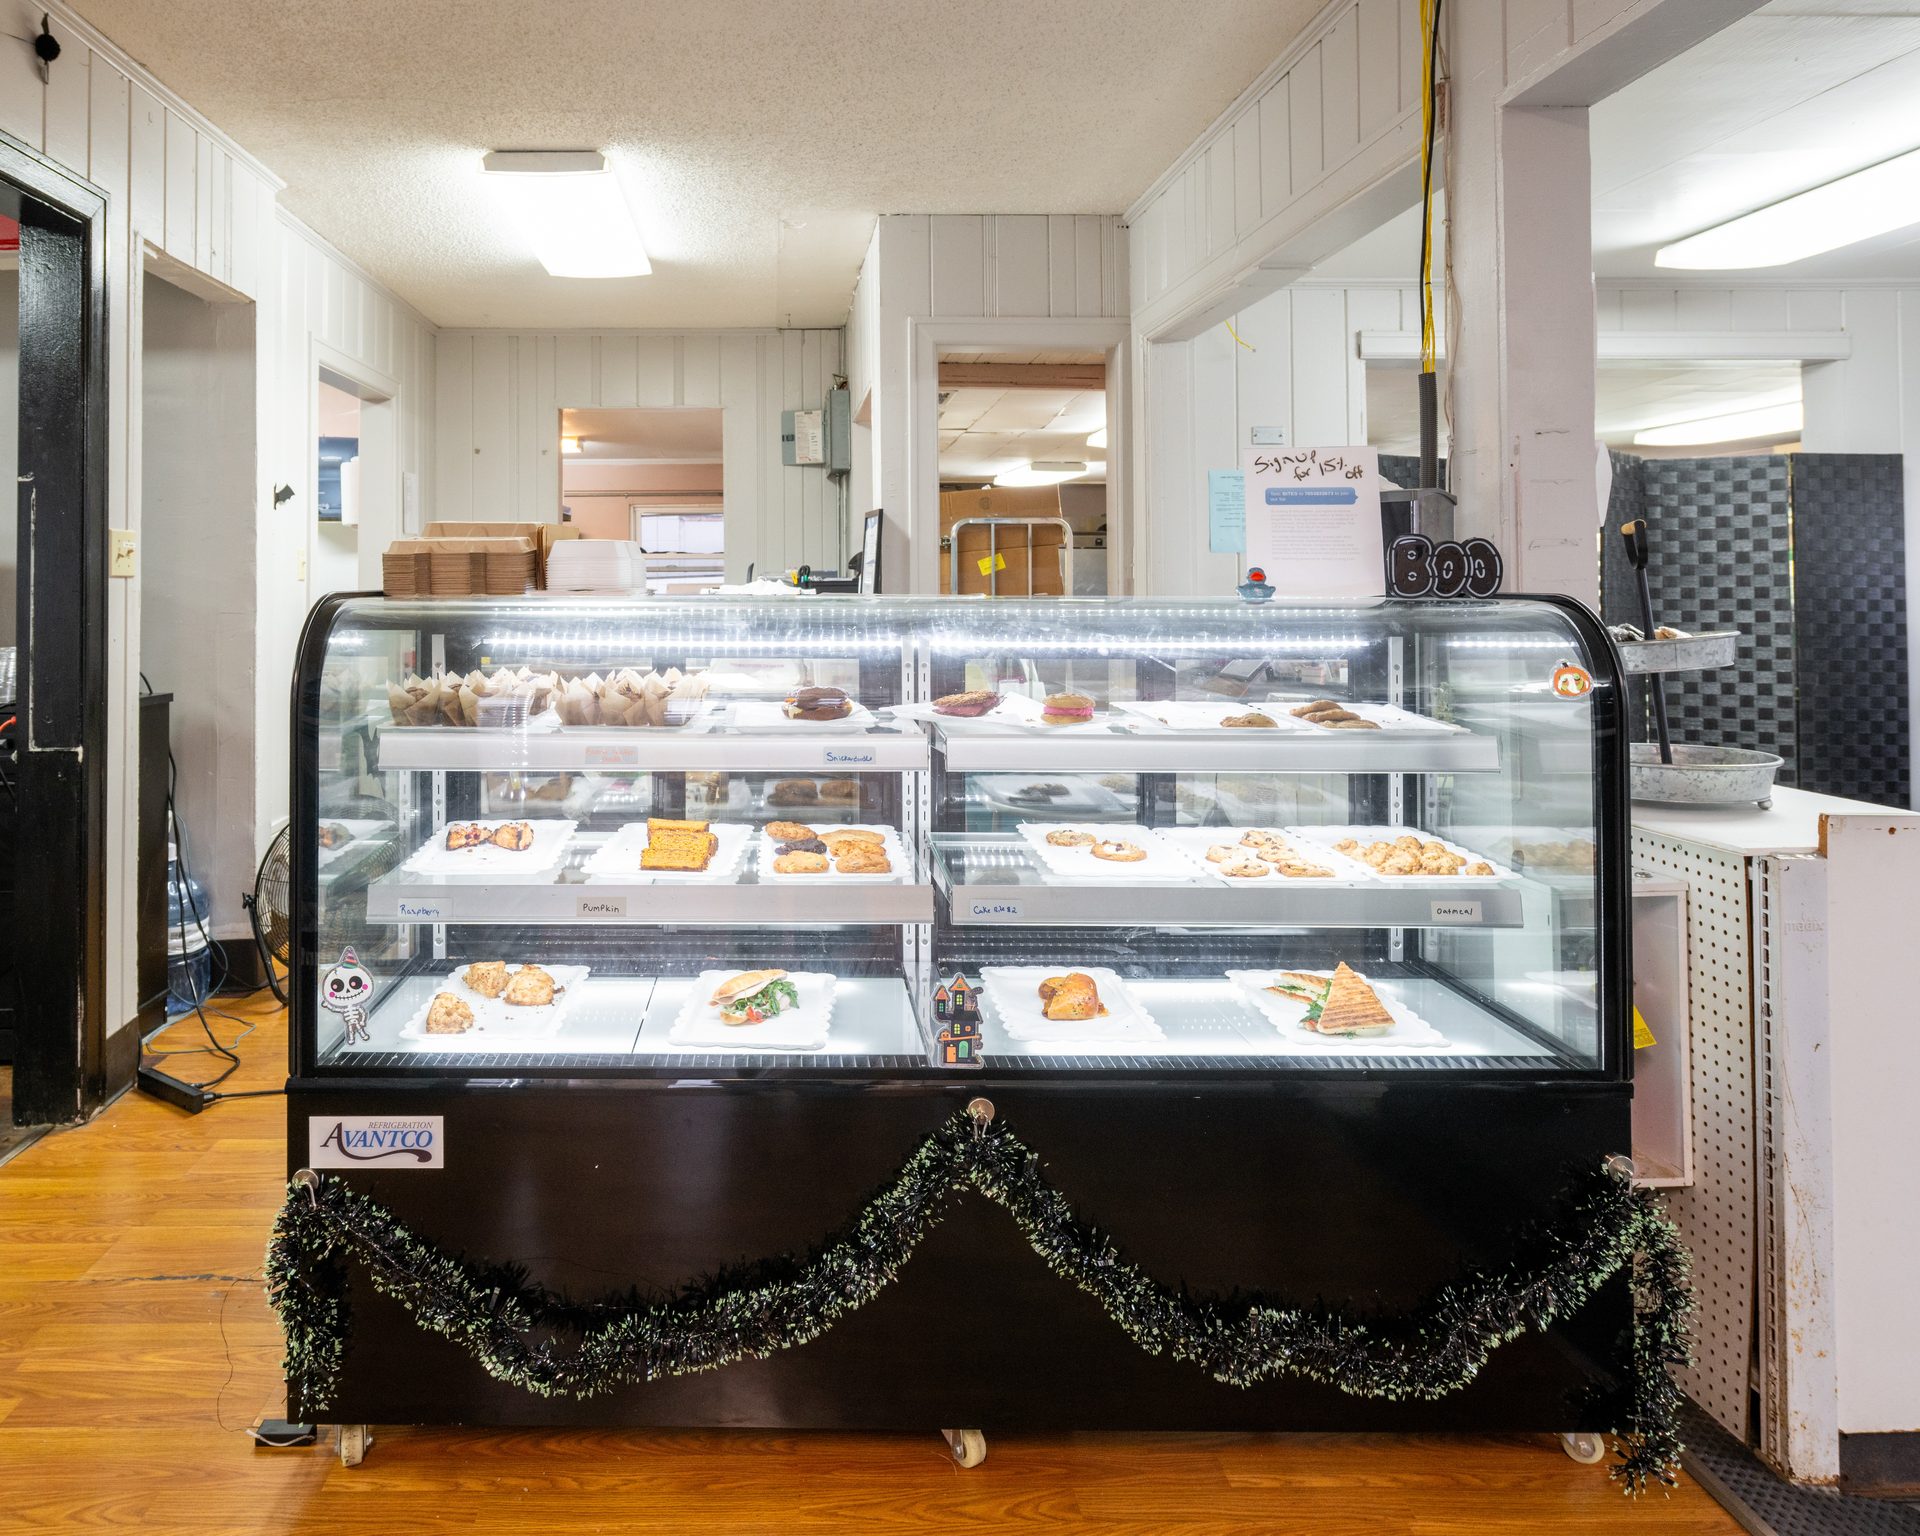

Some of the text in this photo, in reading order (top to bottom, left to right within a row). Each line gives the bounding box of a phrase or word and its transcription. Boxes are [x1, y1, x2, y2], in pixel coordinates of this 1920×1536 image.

[1254, 456, 1294, 474] Sign
[1293, 457, 1364, 481] for 15% off
[1389, 535, 1502, 598] BOO
[399, 904, 440, 917] Raspberry
[1437, 908, 1473, 916] Oatmeal
[368, 1121, 433, 1129] REFRIGERATION
